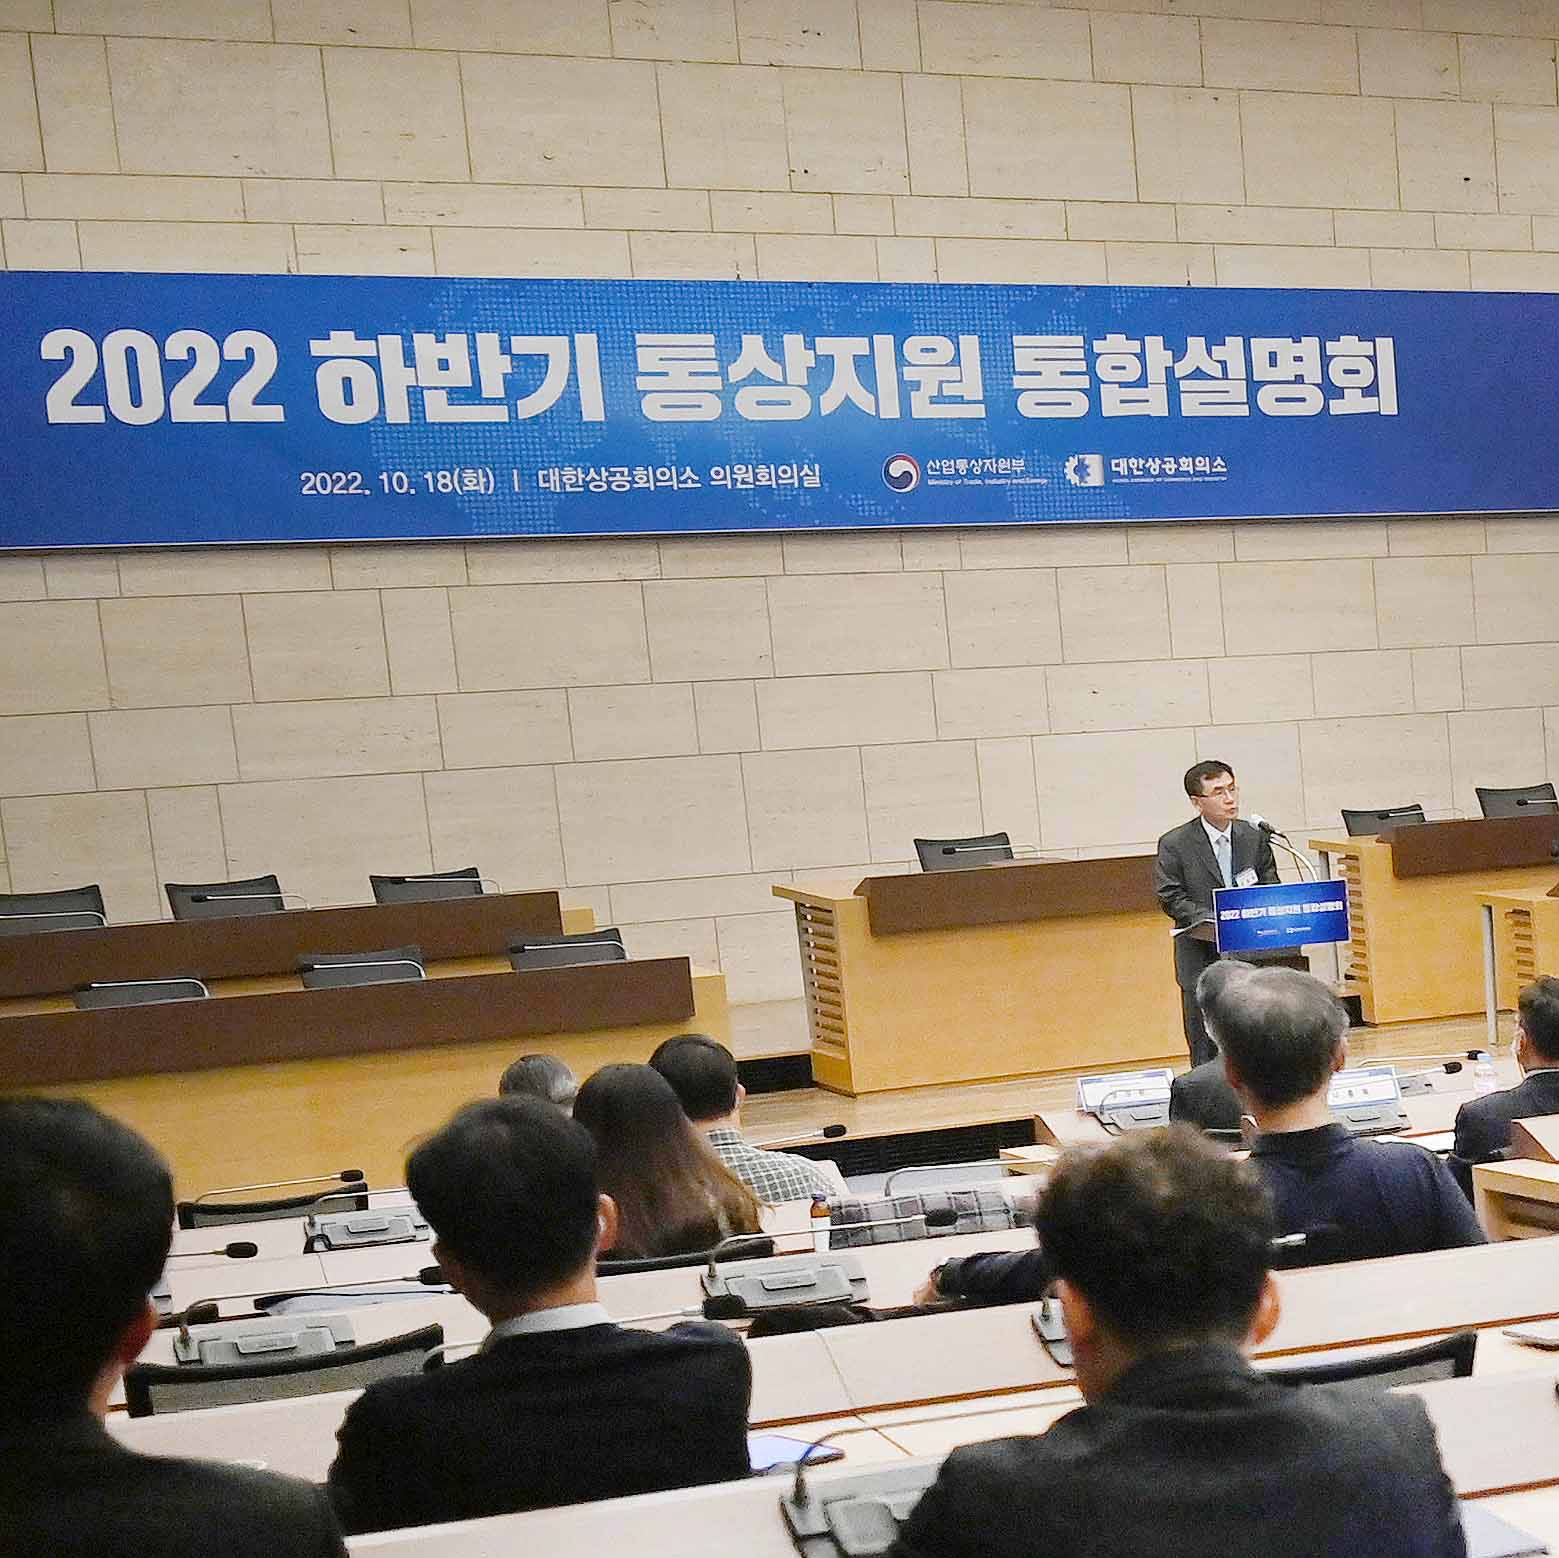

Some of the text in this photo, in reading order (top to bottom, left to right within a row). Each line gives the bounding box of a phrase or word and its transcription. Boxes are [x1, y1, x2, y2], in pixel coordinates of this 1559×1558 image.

[40, 328, 1399, 426] 2022 하반기 통상지원 통합설명회
[927, 458, 1025, 475] 산업통상자원부
[1111, 456, 1228, 476] 대한상공회의소
[299, 471, 371, 495] 2022.
[378, 470, 417, 495] 10.
[423, 467, 495, 496] 18(화)
[537, 465, 702, 493] 대한상공회의소
[709, 463, 822, 489] 의원회의실
